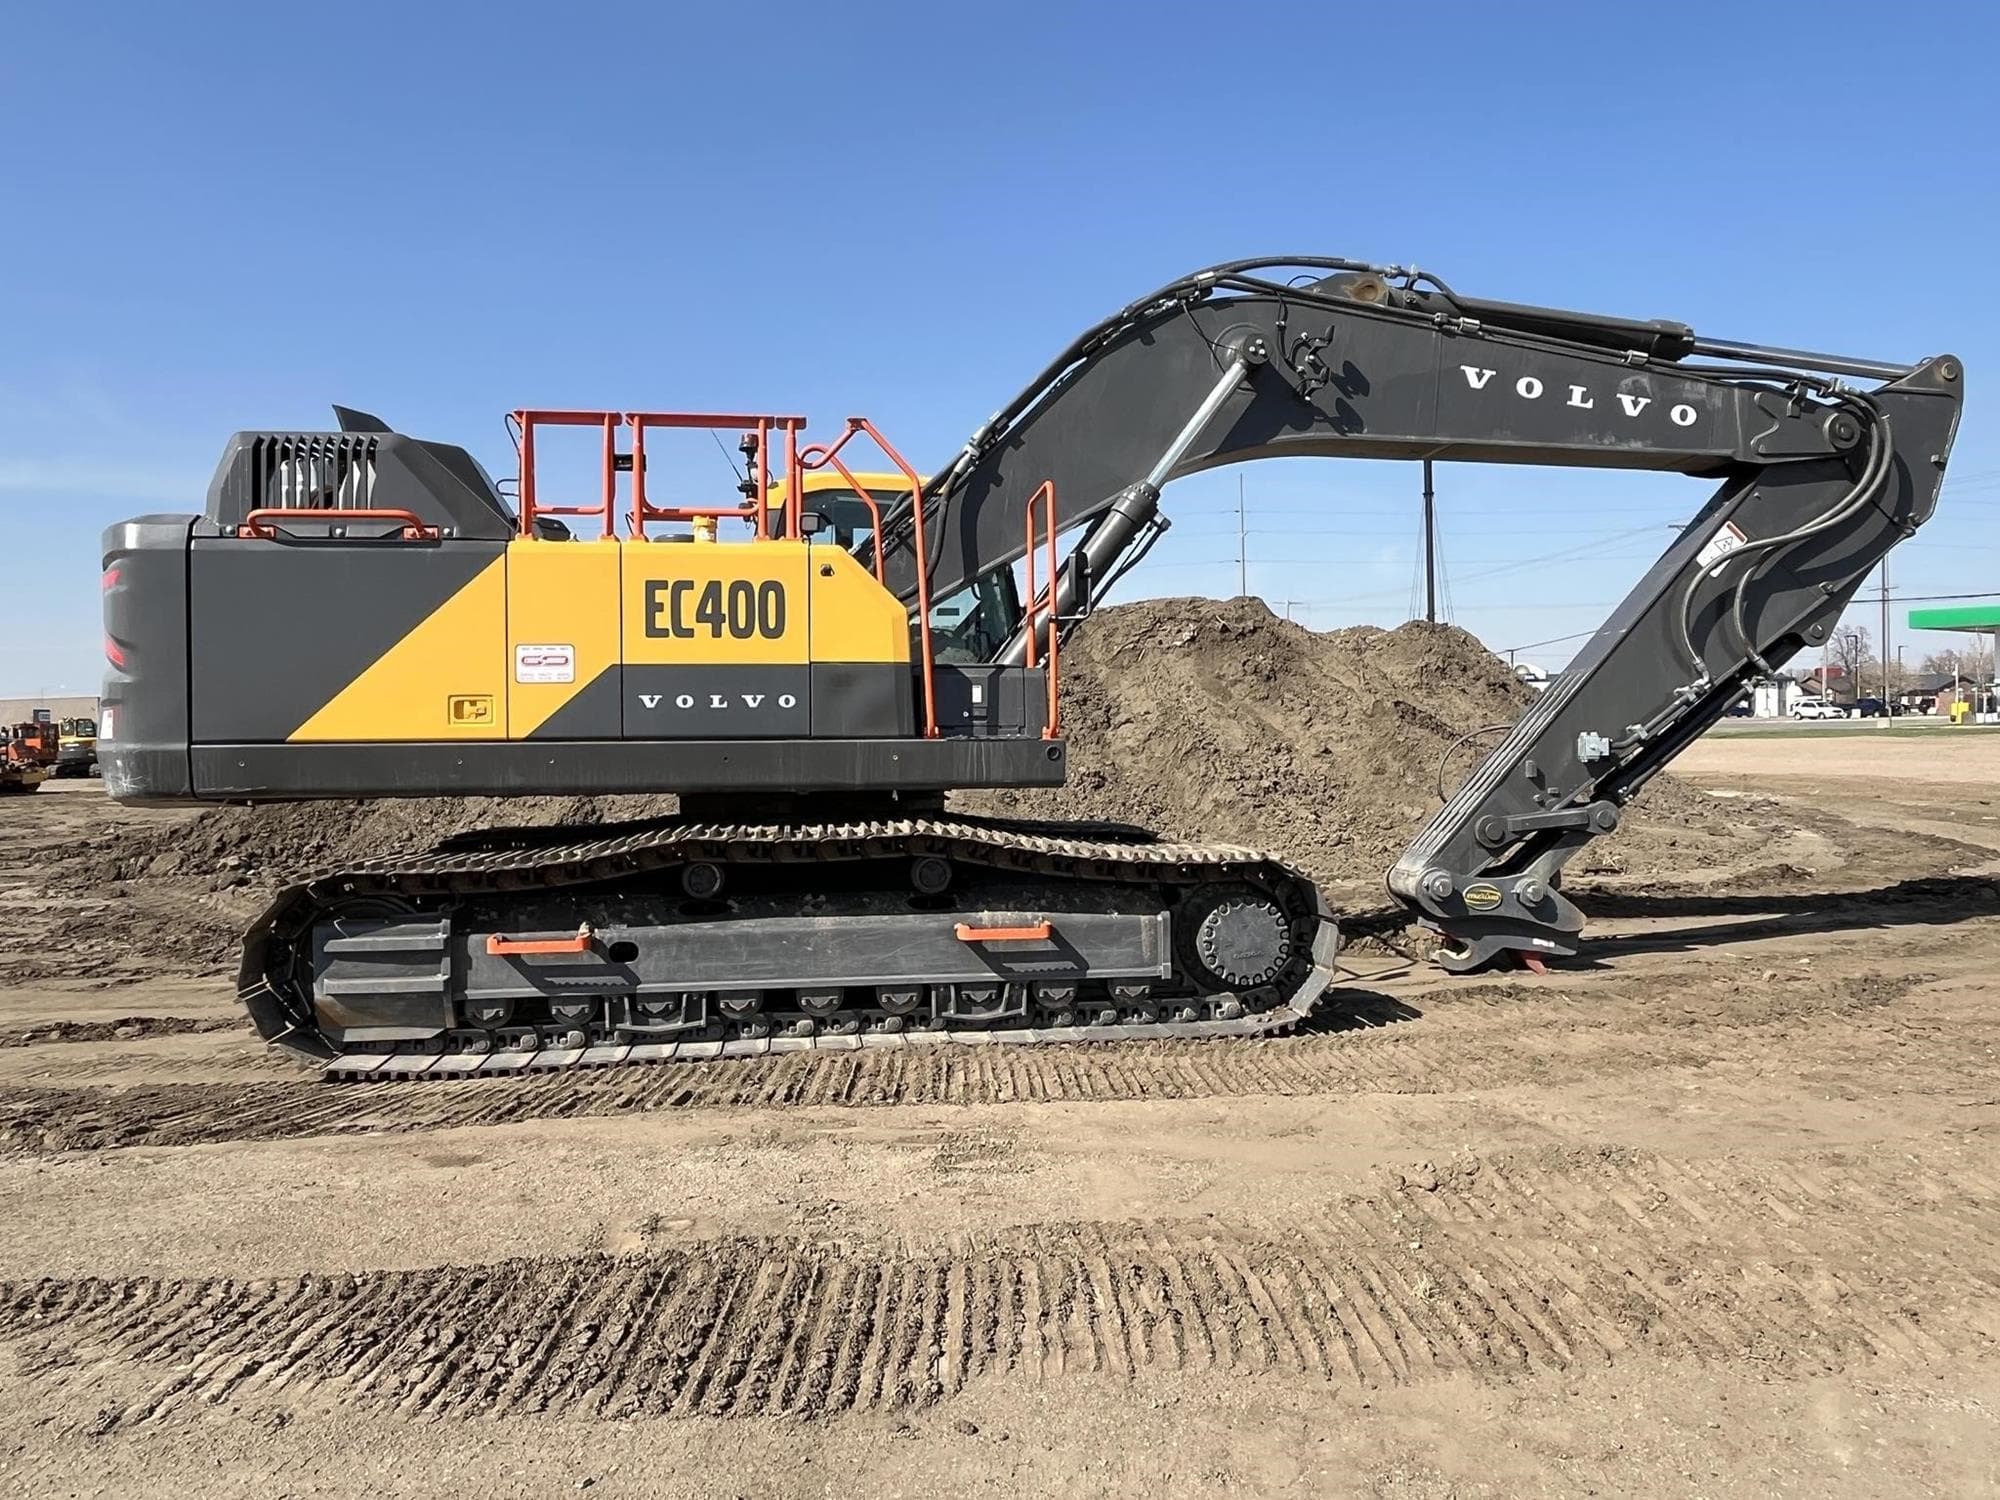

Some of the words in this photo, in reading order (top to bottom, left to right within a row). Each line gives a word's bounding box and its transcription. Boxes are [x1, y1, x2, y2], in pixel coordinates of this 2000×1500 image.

[1460, 365, 1697, 427] VOLVO
[645, 580, 786, 639] EC400
[638, 694, 797, 709] VOLVO
